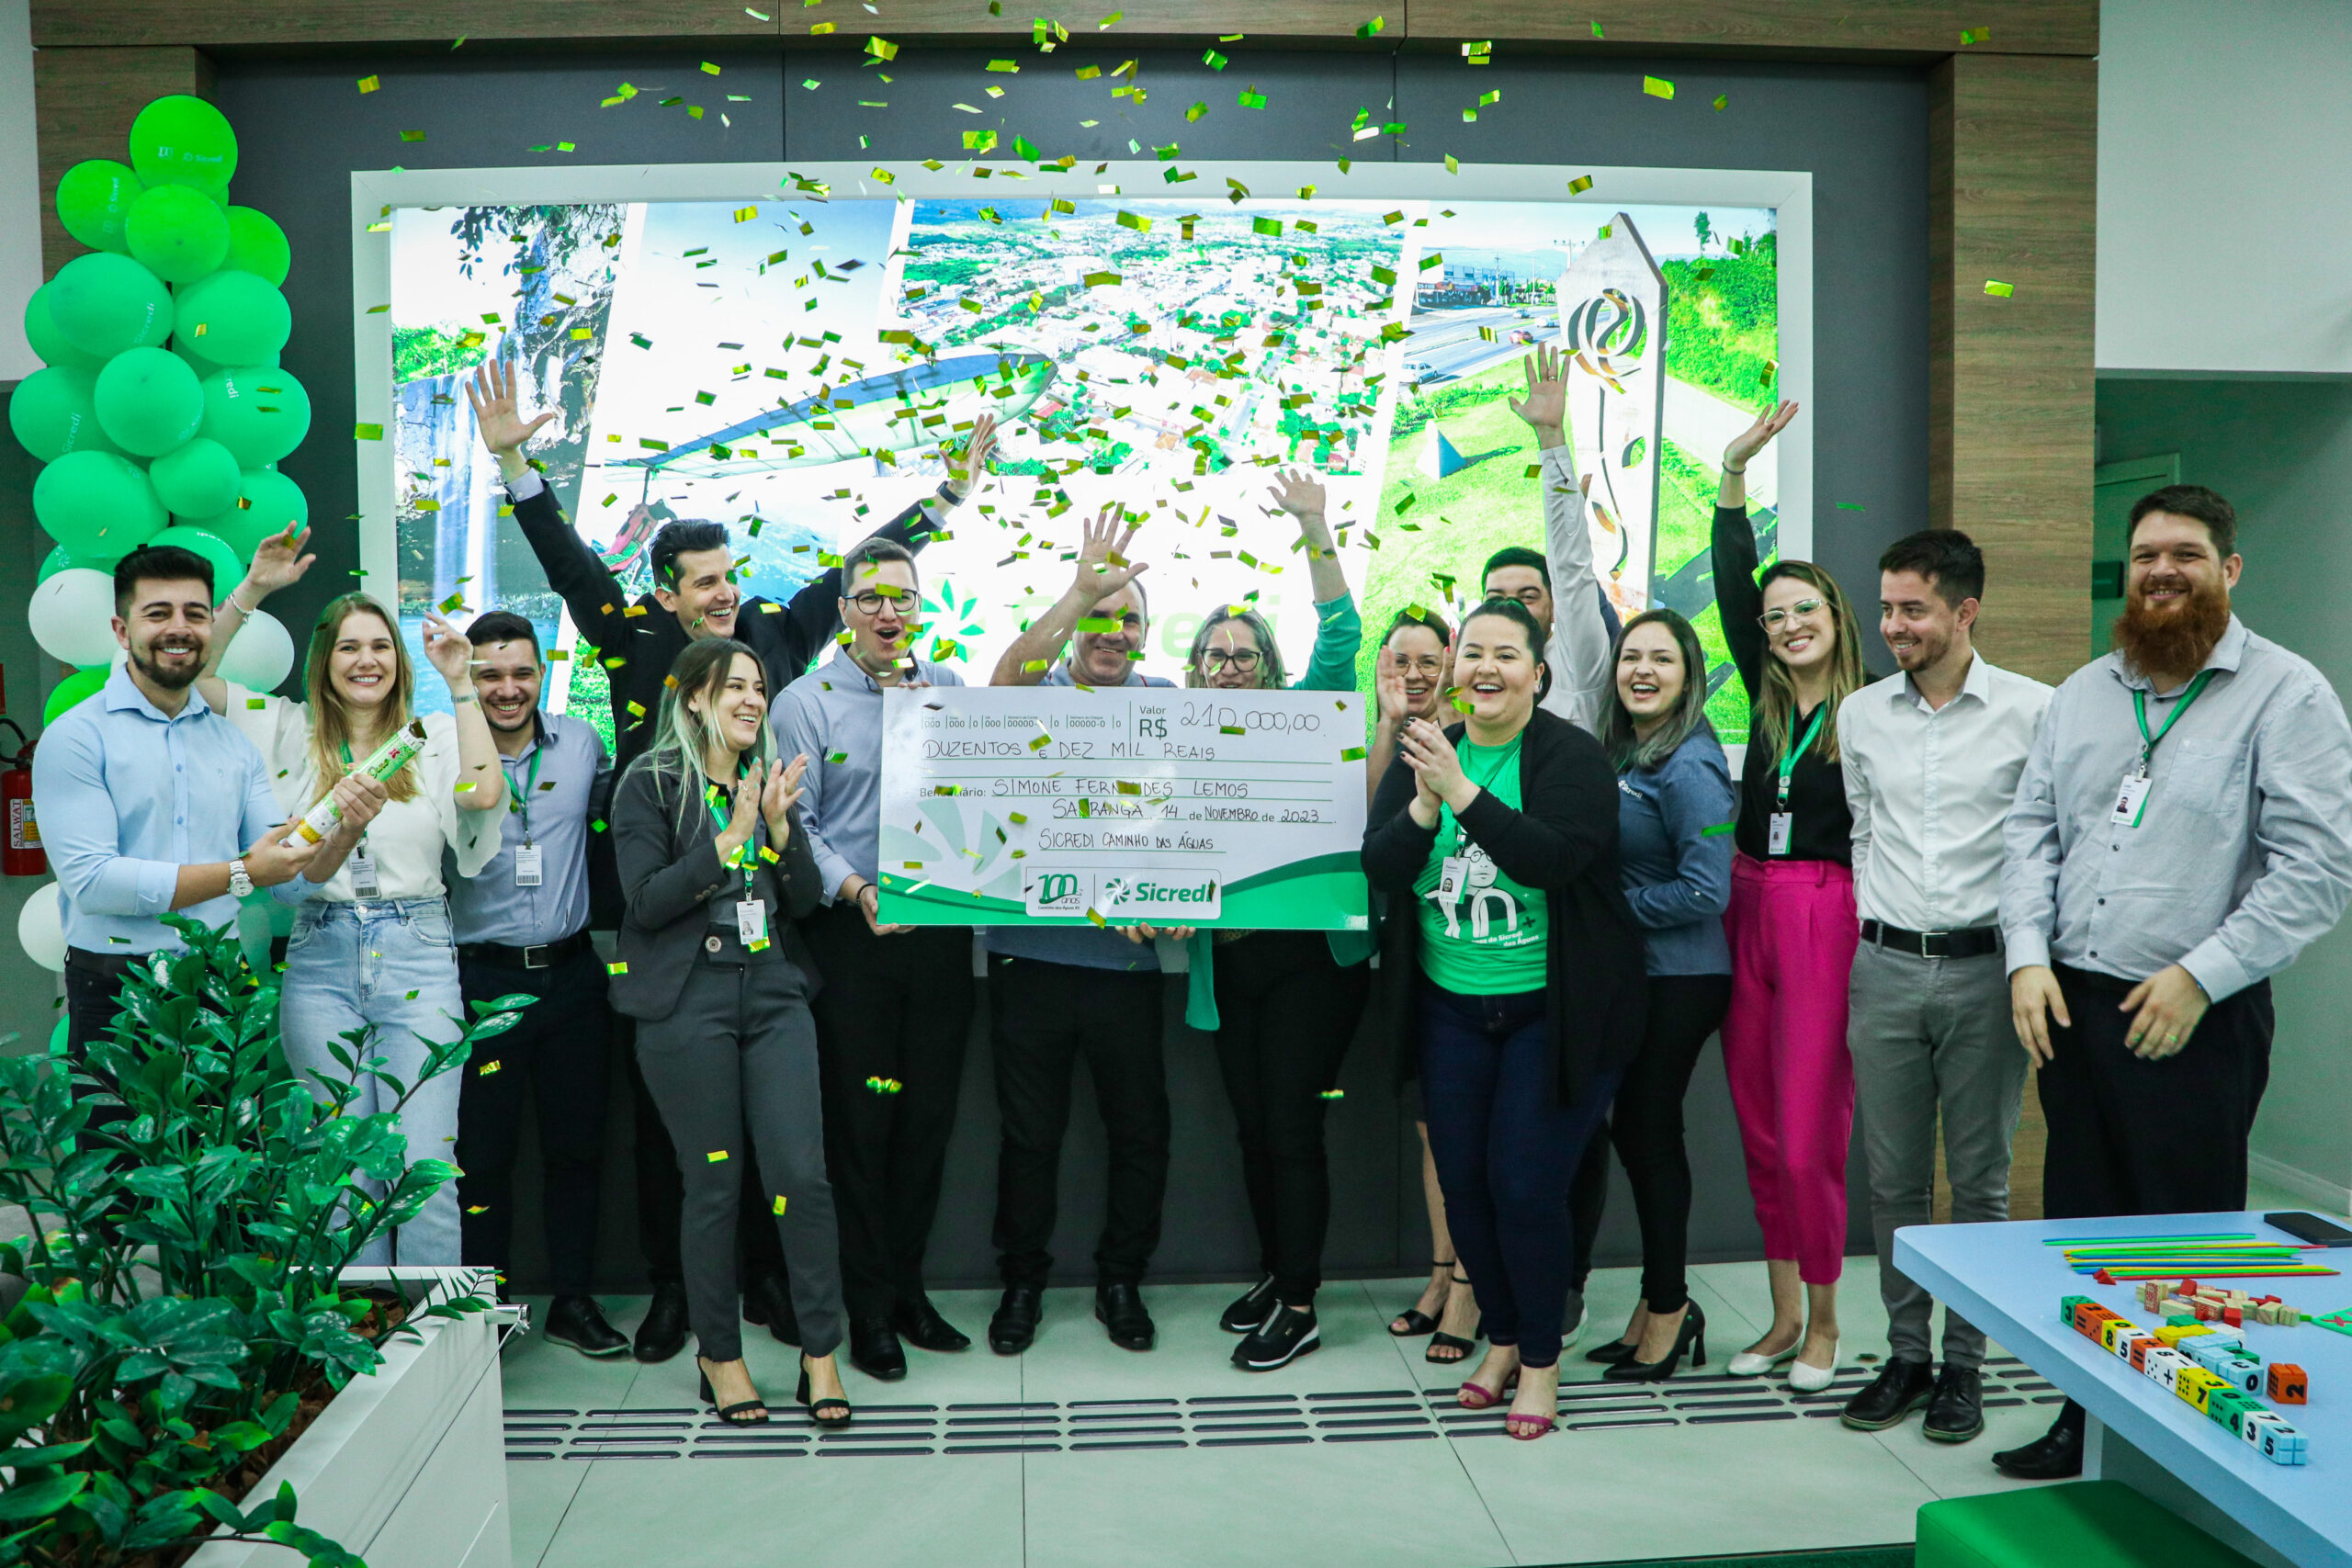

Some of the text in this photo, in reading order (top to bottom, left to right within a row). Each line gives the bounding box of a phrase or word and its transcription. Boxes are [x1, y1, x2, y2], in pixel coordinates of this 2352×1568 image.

[1139, 705, 1166, 715] Valor
[949, 719, 966, 728] 000
[985, 719, 1001, 728] 000
[1007, 719, 1044, 728] 00000-
[1139, 717, 1168, 740] R$
[922, 739, 1022, 759] DUZENTOS
[1058, 741, 1096, 760] DEZ
[1112, 741, 1145, 758] MIL
[1164, 742, 1216, 761] REAIS
[992, 778, 1249, 798] SIMONE FERNDES LEMOS
[1160, 805, 1178, 818] 14
[1189, 811, 1203, 821] de
[1204, 806, 1259, 821] NOVEMBRO
[1261, 813, 1275, 823] de
[1281, 809, 1319, 823] 2023
[1039, 829, 1214, 850] SICREDI CAMINHO DAS ÁGUAS
